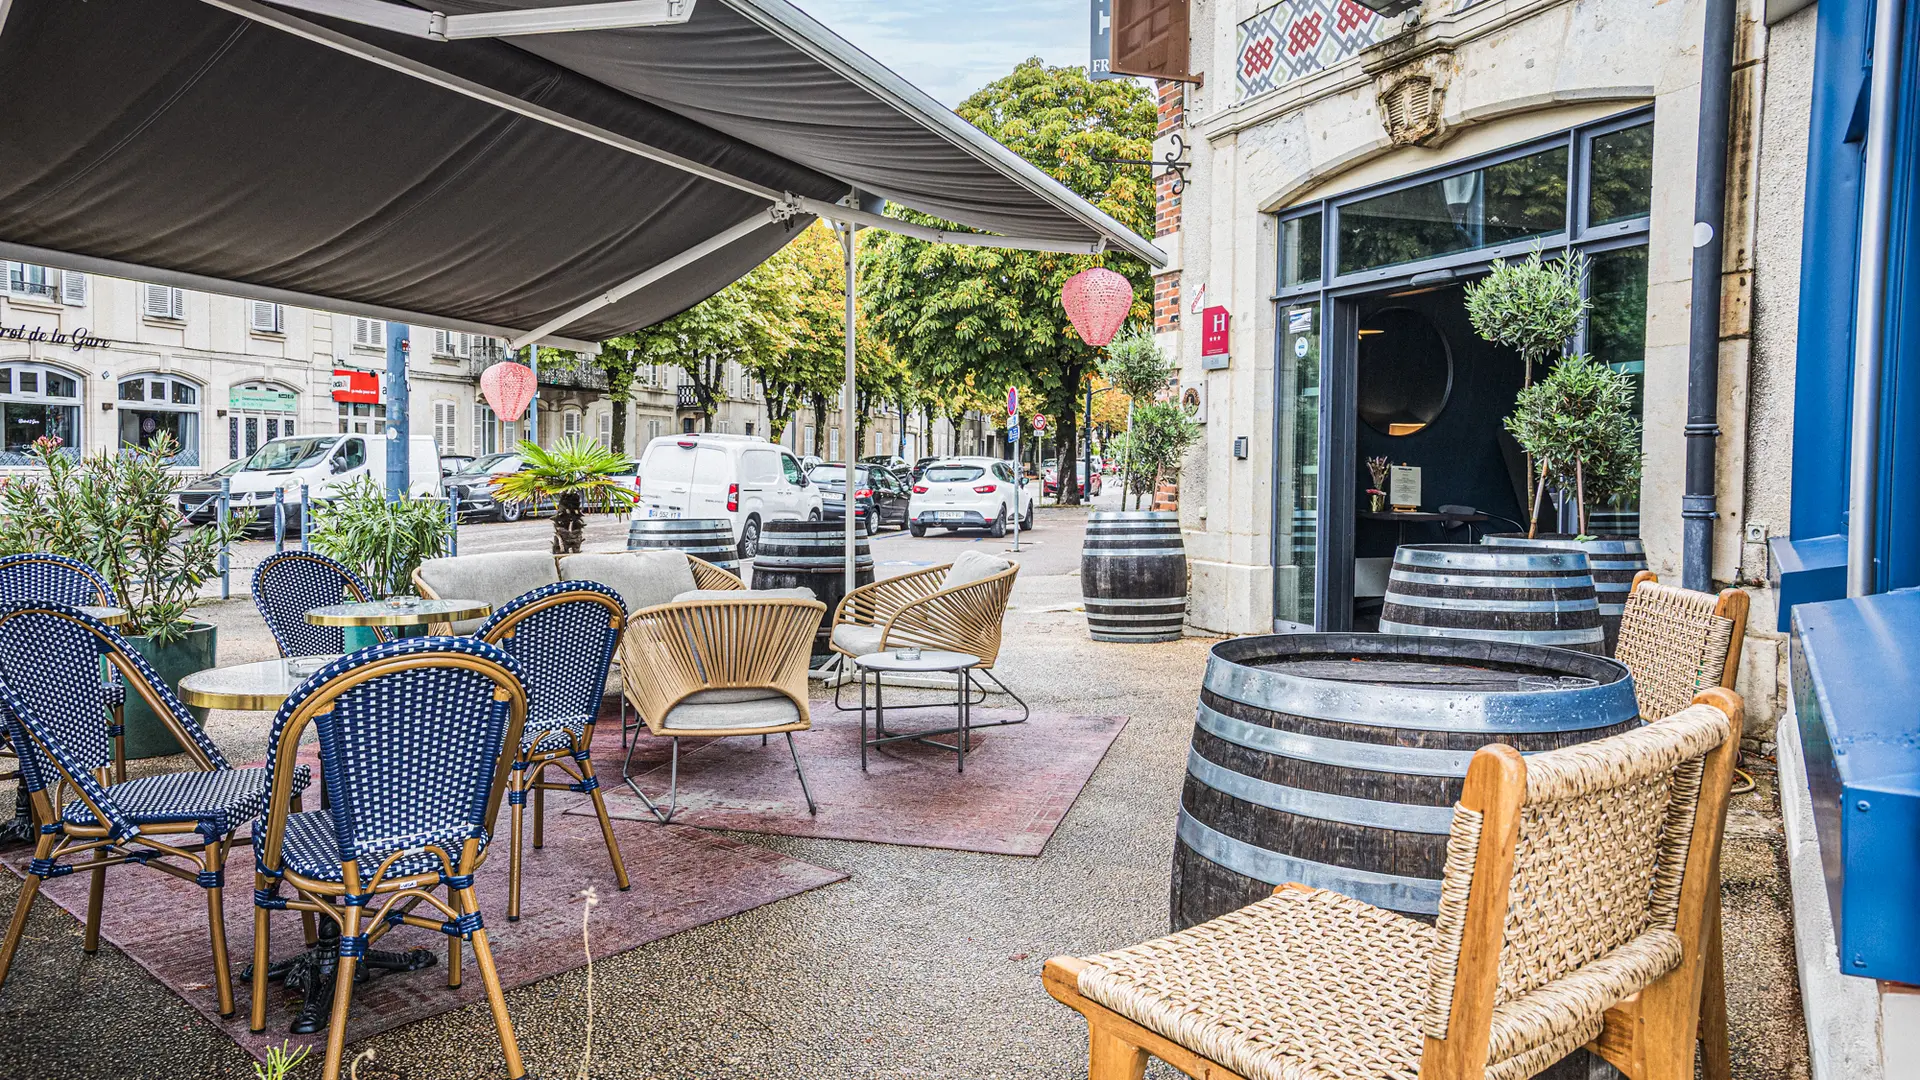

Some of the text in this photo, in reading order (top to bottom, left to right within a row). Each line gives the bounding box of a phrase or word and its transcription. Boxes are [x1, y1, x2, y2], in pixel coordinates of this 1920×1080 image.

[1092, 59, 1110, 73] FR
[1213, 312, 1226, 333] H
[0, 323, 110, 352] rot de la Gare
